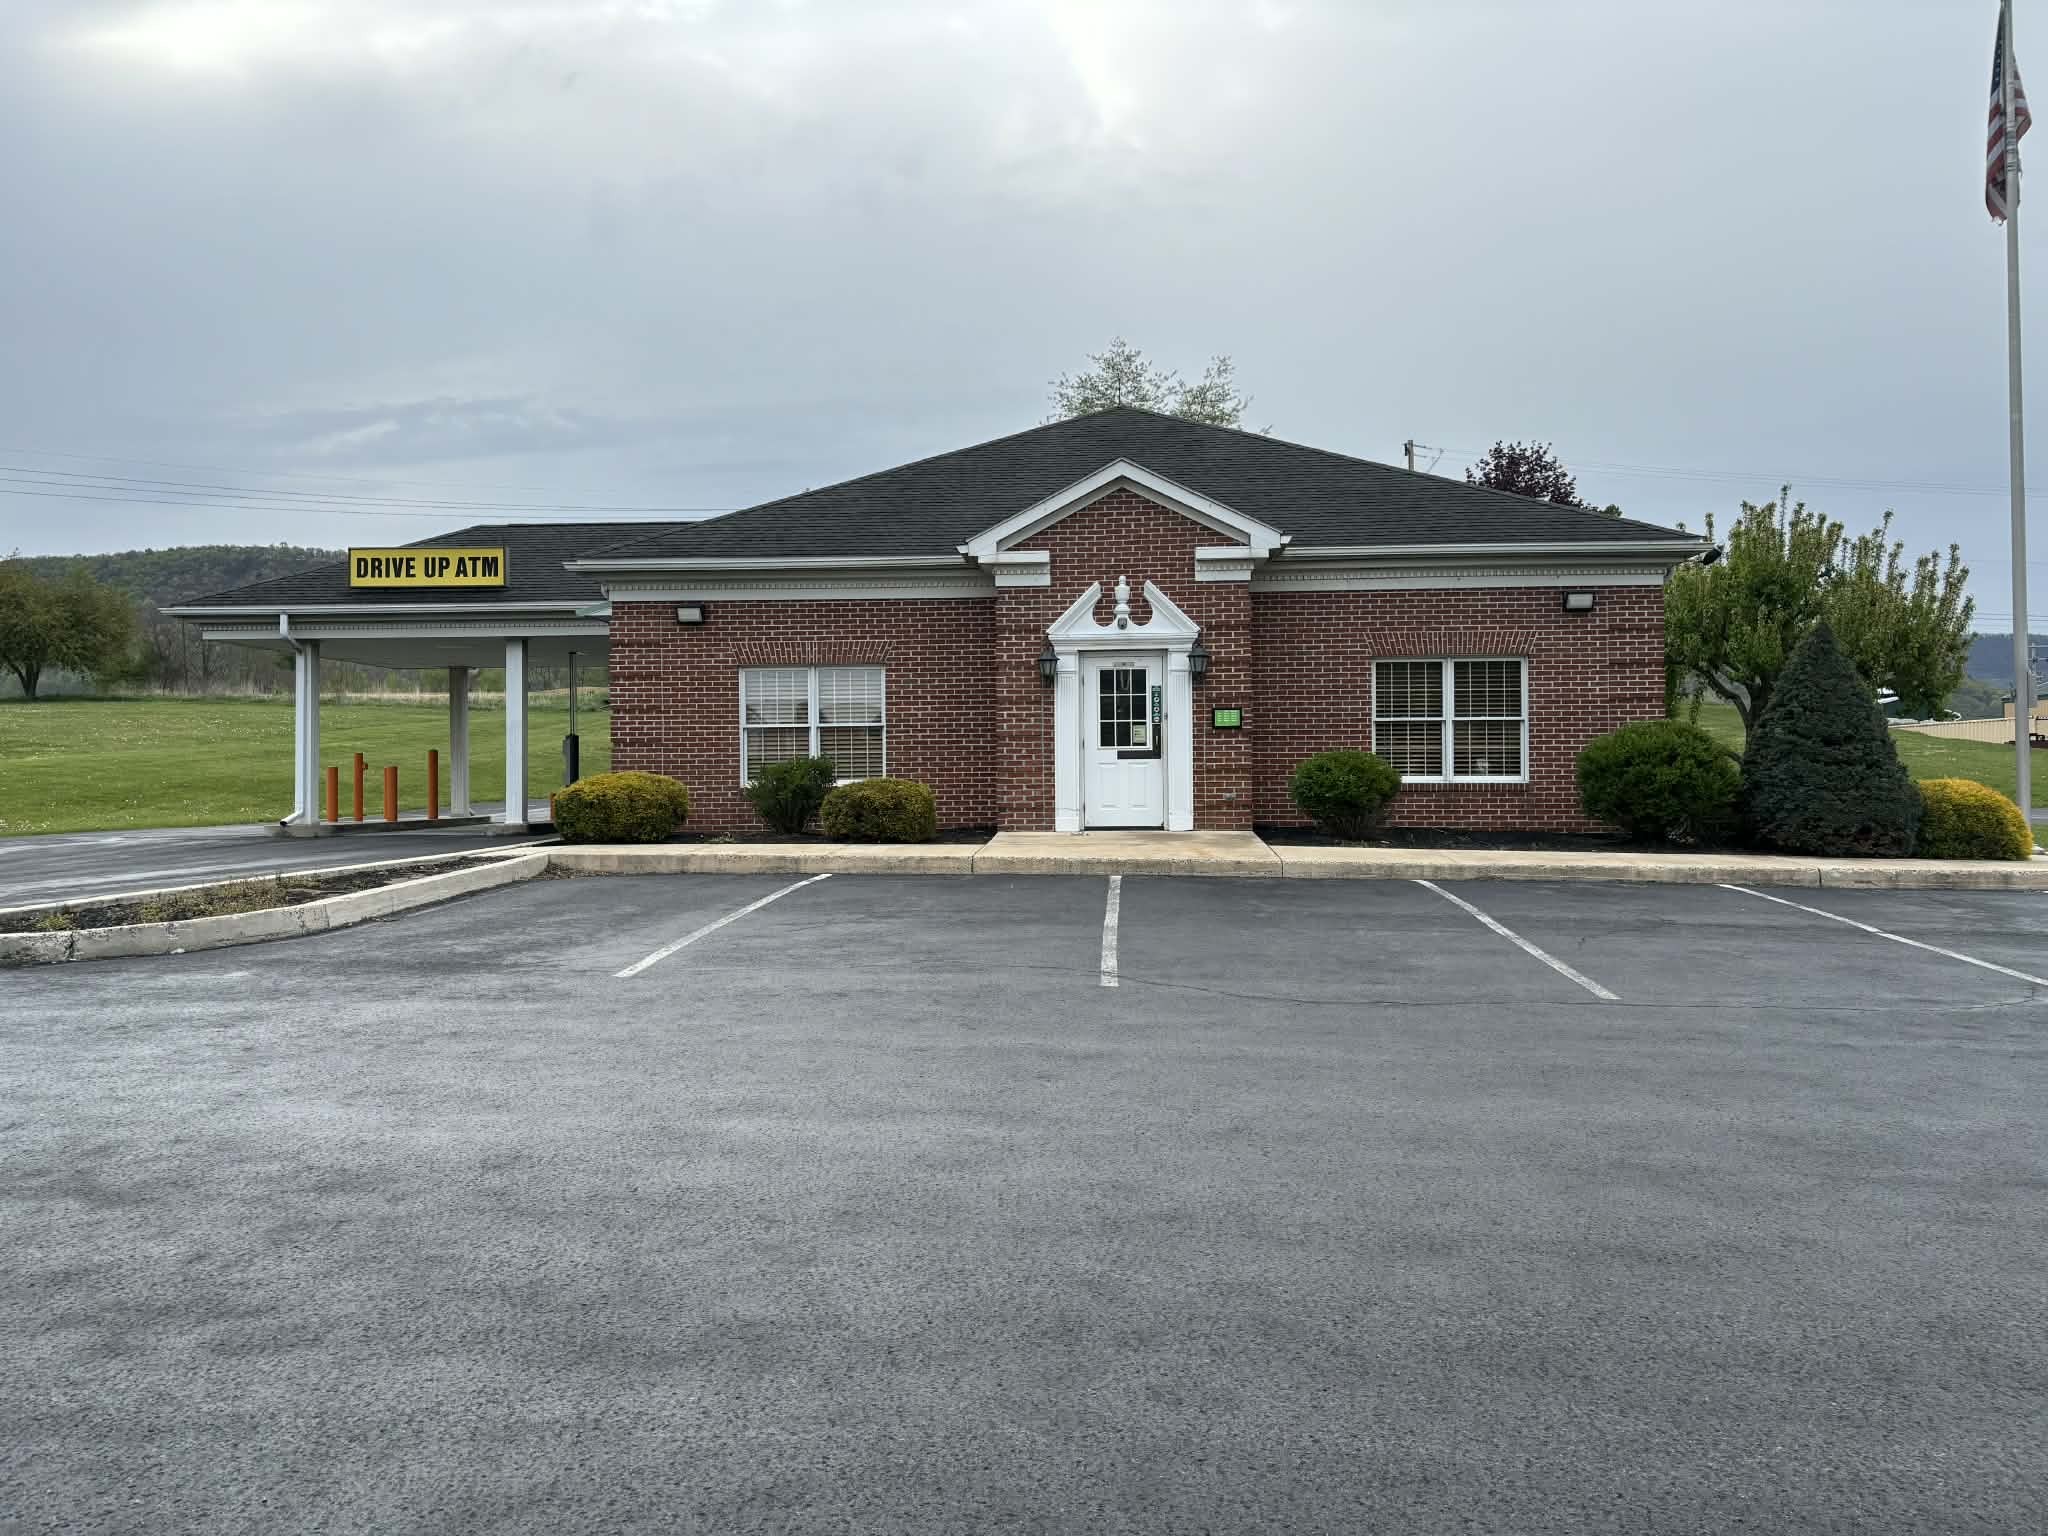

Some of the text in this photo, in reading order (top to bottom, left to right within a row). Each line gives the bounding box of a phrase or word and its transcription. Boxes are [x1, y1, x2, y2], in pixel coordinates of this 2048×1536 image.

[356, 556, 499, 578] DRIVE UP ATM
